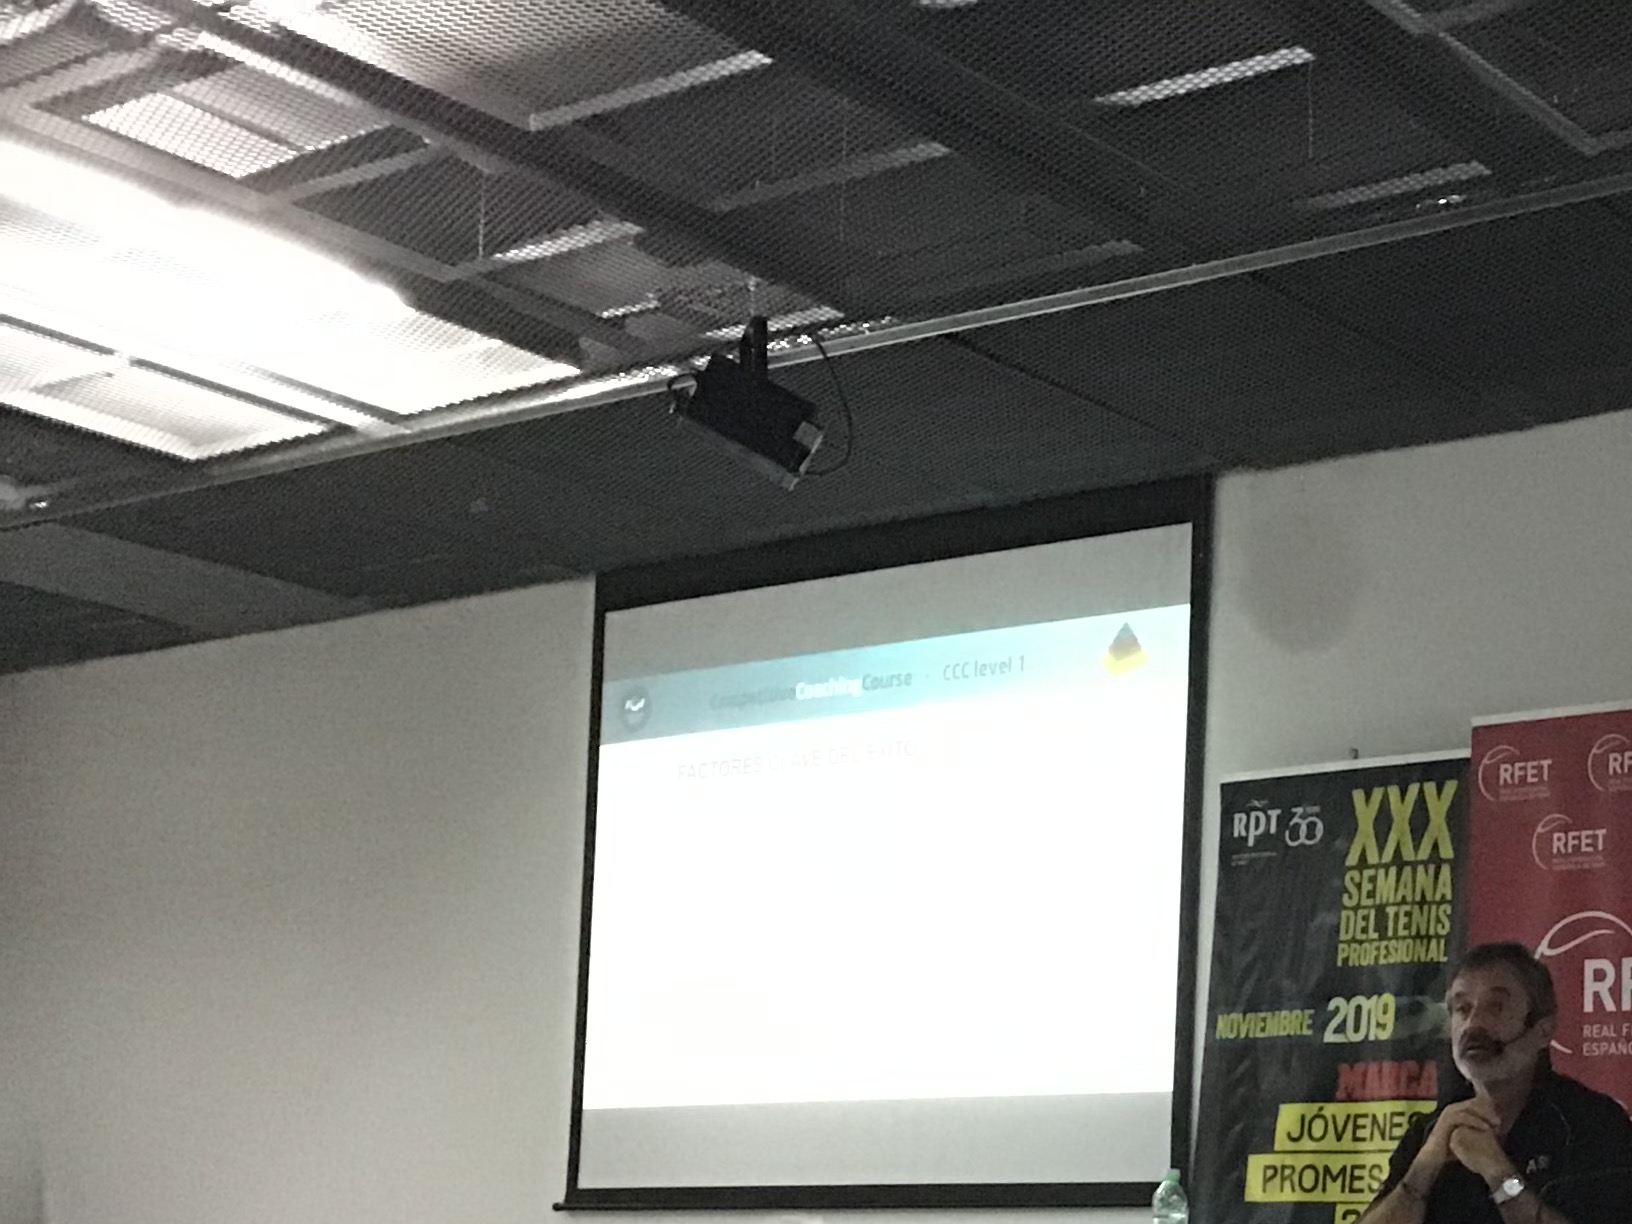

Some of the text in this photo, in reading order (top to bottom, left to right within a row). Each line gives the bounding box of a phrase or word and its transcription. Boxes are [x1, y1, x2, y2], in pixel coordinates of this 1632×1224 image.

[862, 672, 912, 691] Course
[943, 661, 969, 681] CCC
[974, 656, 1012, 678] level
[1500, 759, 1553, 785] RFET
[1345, 780, 1458, 866] XXX
[1552, 828, 1607, 854] RFET
[1342, 864, 1453, 907] SEMANA
[1339, 903, 1452, 941] DEL TENIS
[1336, 938, 1449, 967] PROFESIONAL
[1216, 992, 1396, 1043] NOVIEMBRE 2019
[1583, 1024, 1617, 1038] REAL
[1262, 1164, 1383, 1194] PROMES
